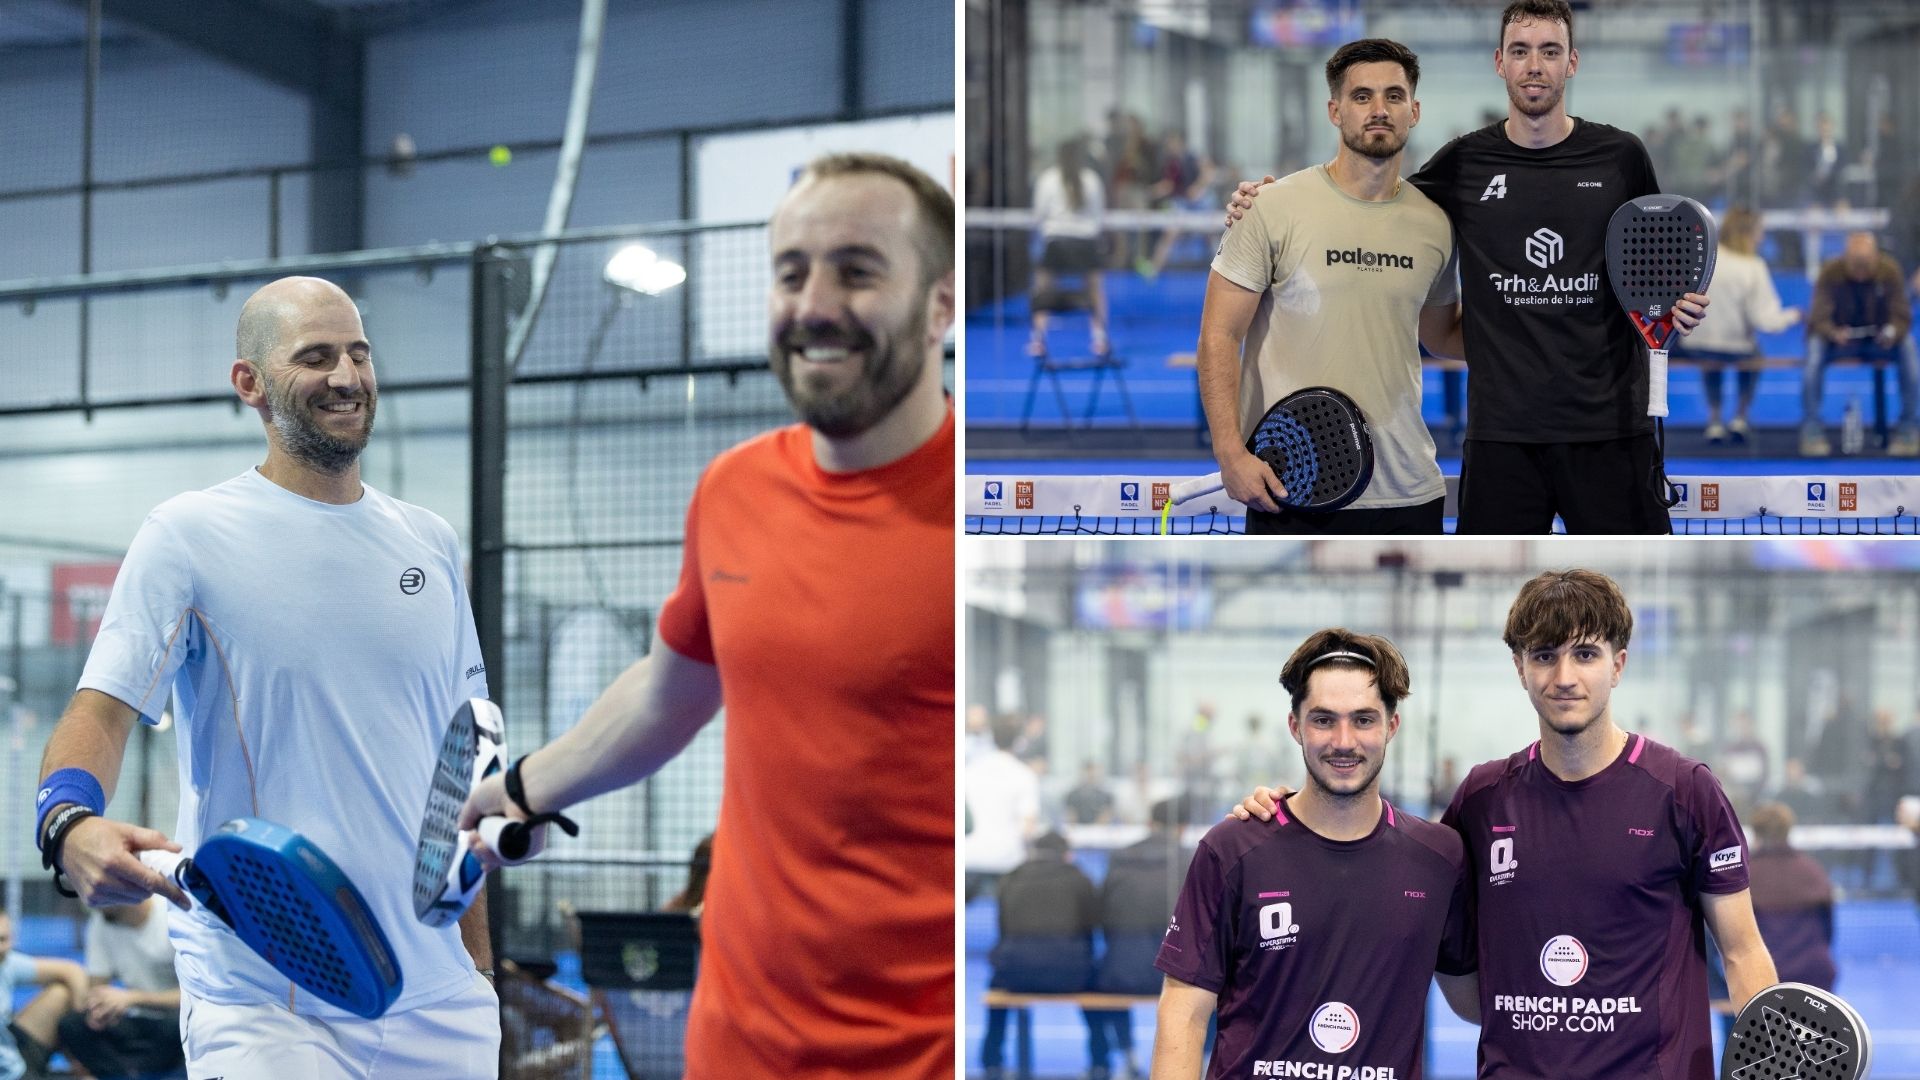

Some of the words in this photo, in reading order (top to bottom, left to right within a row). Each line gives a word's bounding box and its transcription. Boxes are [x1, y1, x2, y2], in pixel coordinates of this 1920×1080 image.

[1326, 248, 1414, 269] paloma
[1514, 296, 1549, 306] gestion
[1551, 294, 1563, 304] de
[1565, 294, 1574, 304] la
[1018, 484, 1031, 494] TEN
[1154, 486, 1168, 495] TEN
[1703, 486, 1717, 496] TEN
[1841, 486, 1855, 495] TEN
[1018, 498, 1031, 507] NIS
[1703, 500, 1717, 509] NIS
[1841, 499, 1854, 508] NIS
[1714, 851, 1736, 862] Krys
[1495, 994, 1567, 1013] FRENCH
[1572, 996, 1642, 1014] PADEL
[1512, 1013, 1615, 1033] SHOP.COM
[1253, 1060, 1334, 1080] FRENCH
[1337, 1065, 1398, 1080] PADEL
